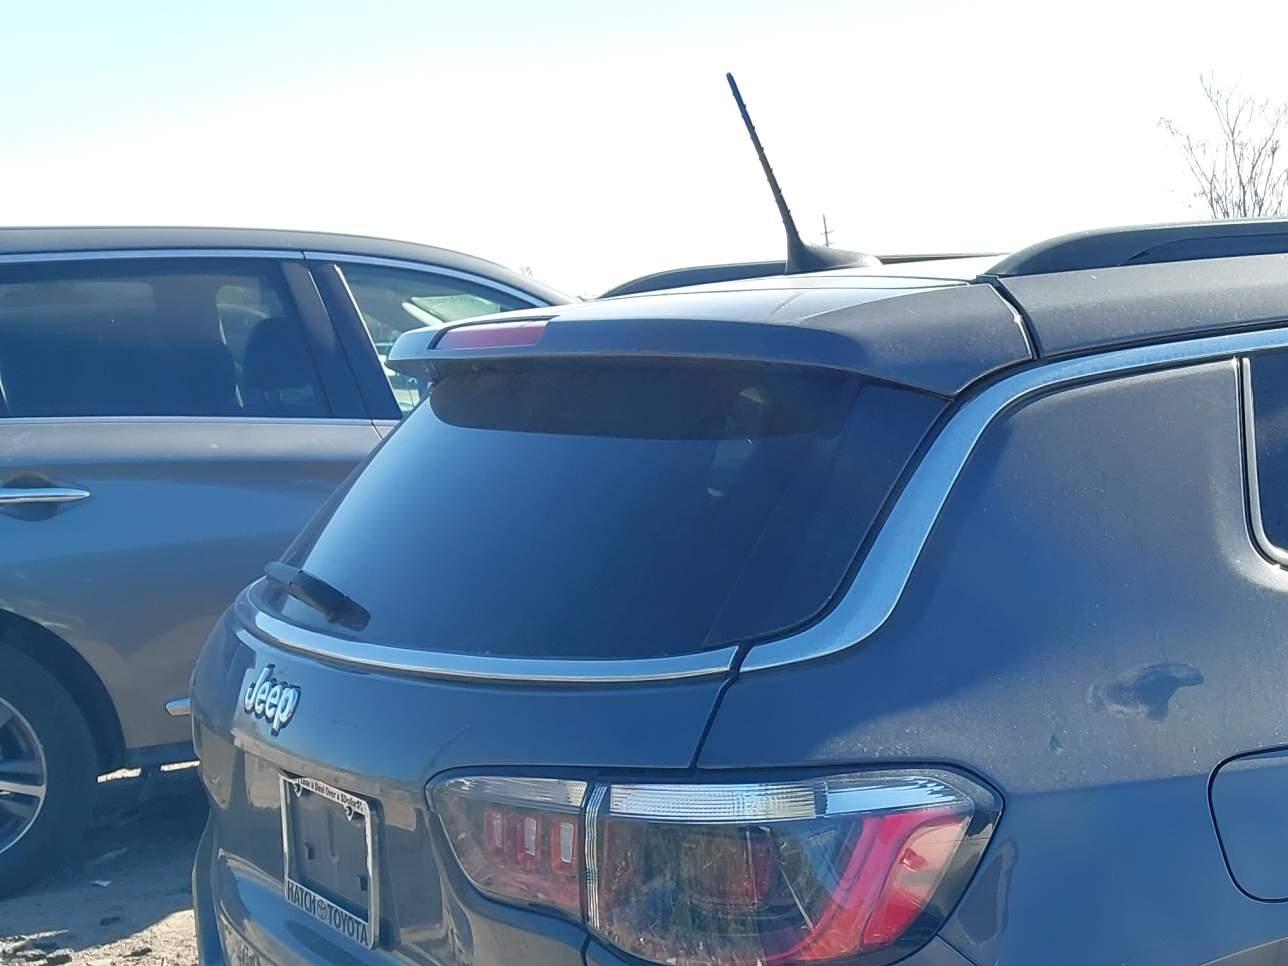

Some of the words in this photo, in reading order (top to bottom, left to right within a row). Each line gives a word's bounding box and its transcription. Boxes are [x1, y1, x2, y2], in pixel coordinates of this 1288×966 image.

[244, 664, 301, 737] Jeep
[287, 881, 316, 916] HATCH
[327, 903, 368, 947] TOYOTA
